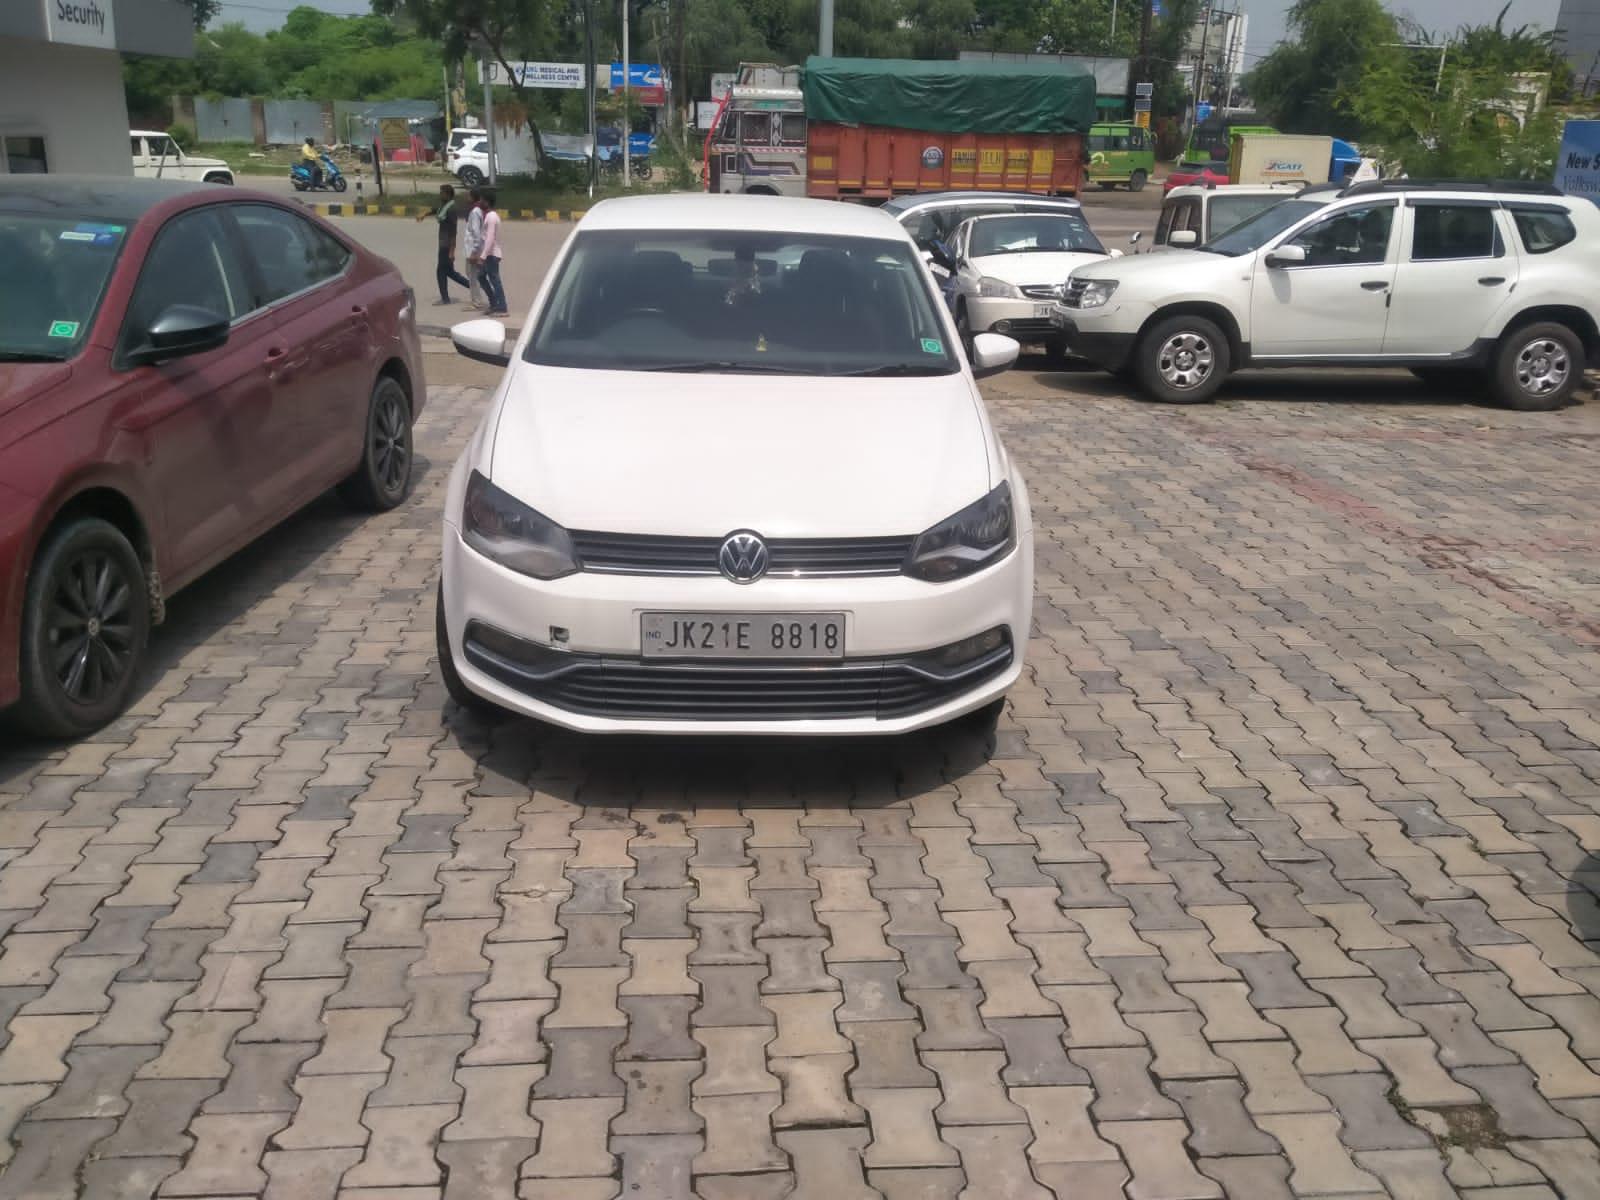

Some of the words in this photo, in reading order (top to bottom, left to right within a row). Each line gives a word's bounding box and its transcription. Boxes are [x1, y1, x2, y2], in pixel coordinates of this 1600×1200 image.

[58, 0, 105, 34] Security
[1566, 152, 1592, 169] New
[665, 621, 751, 650] JK21E
[771, 622, 839, 650] 8818
